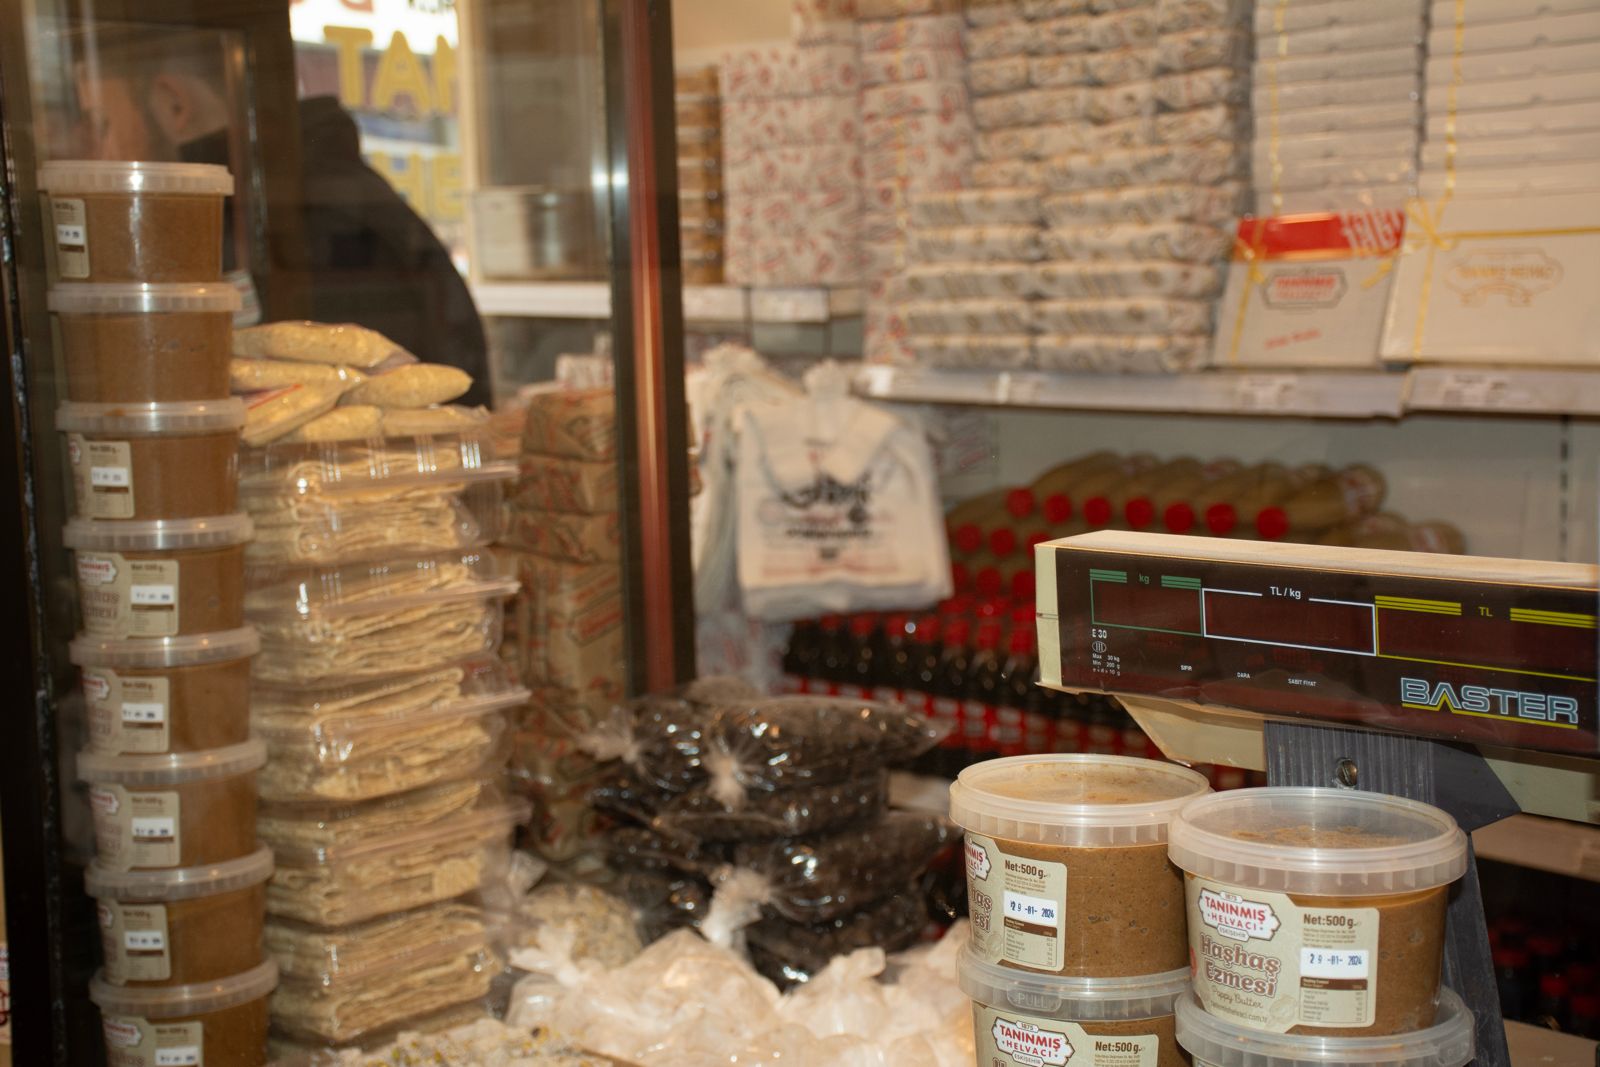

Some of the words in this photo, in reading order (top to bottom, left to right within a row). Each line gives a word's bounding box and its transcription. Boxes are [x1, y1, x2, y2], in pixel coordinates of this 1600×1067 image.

[1139, 573, 1150, 584] kg
[1270, 586, 1283, 596] TL
[1289, 588, 1301, 599] kg
[1478, 606, 1493, 617] TL
[1092, 629, 1097, 638] E
[1098, 629, 1107, 639] 30
[1401, 677, 1578, 724] BASTER
[1005, 860, 1037, 876] Net:500
[1204, 896, 1266, 924] TANINMIŞ
[1211, 912, 1257, 931] HELVACI
[1303, 913, 1346, 927] Net:500
[1200, 933, 1280, 977] Haşhaş
[1205, 959, 1276, 998] Ezmesi
[999, 1025, 1062, 1052] TANINMIŞ
[1095, 1041, 1132, 1052] Net:500
[1006, 1040, 1052, 1058] HELVACI
